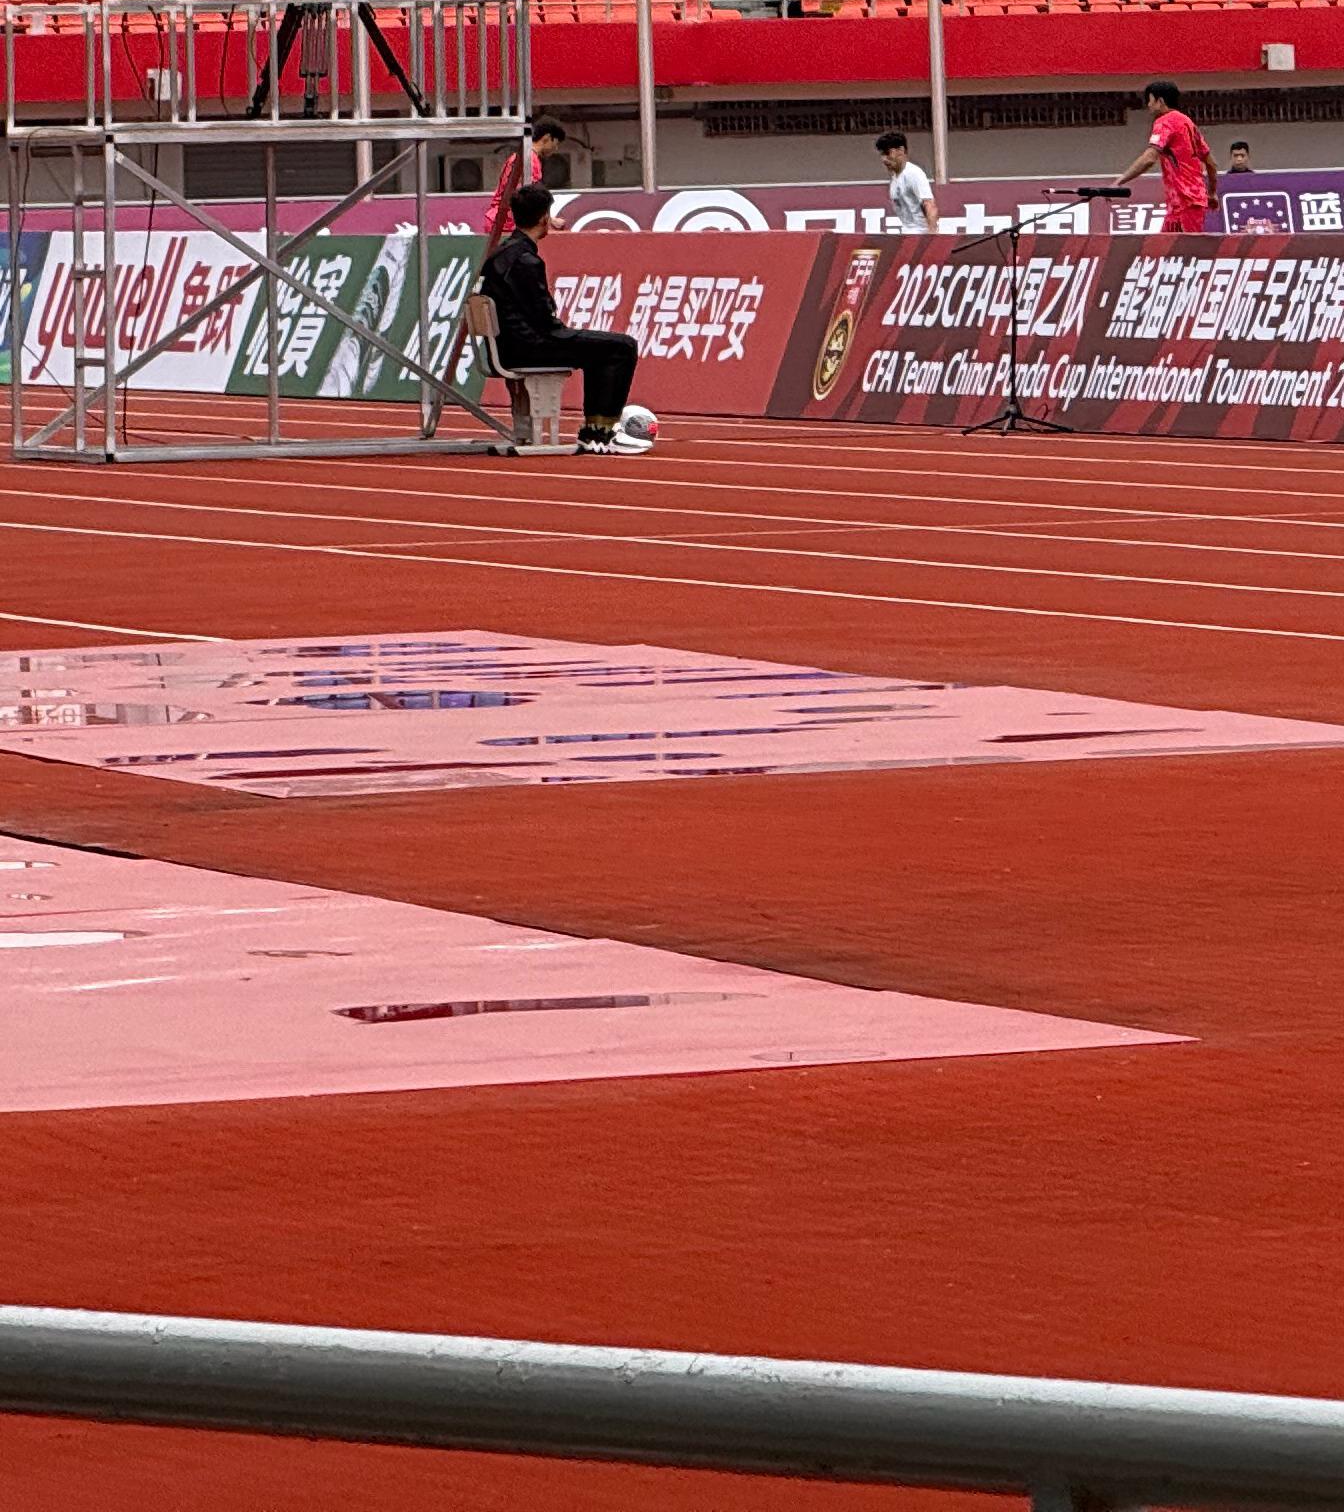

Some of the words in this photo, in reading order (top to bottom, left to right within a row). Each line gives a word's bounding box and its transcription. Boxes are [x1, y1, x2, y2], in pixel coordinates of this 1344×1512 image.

[862, 349, 899, 394] CFA
[896, 350, 945, 395] Team
[942, 347, 995, 396] China
[1049, 354, 1086, 412] Cup
[1086, 352, 1214, 404] International
[1206, 358, 1334, 408] Tournament
